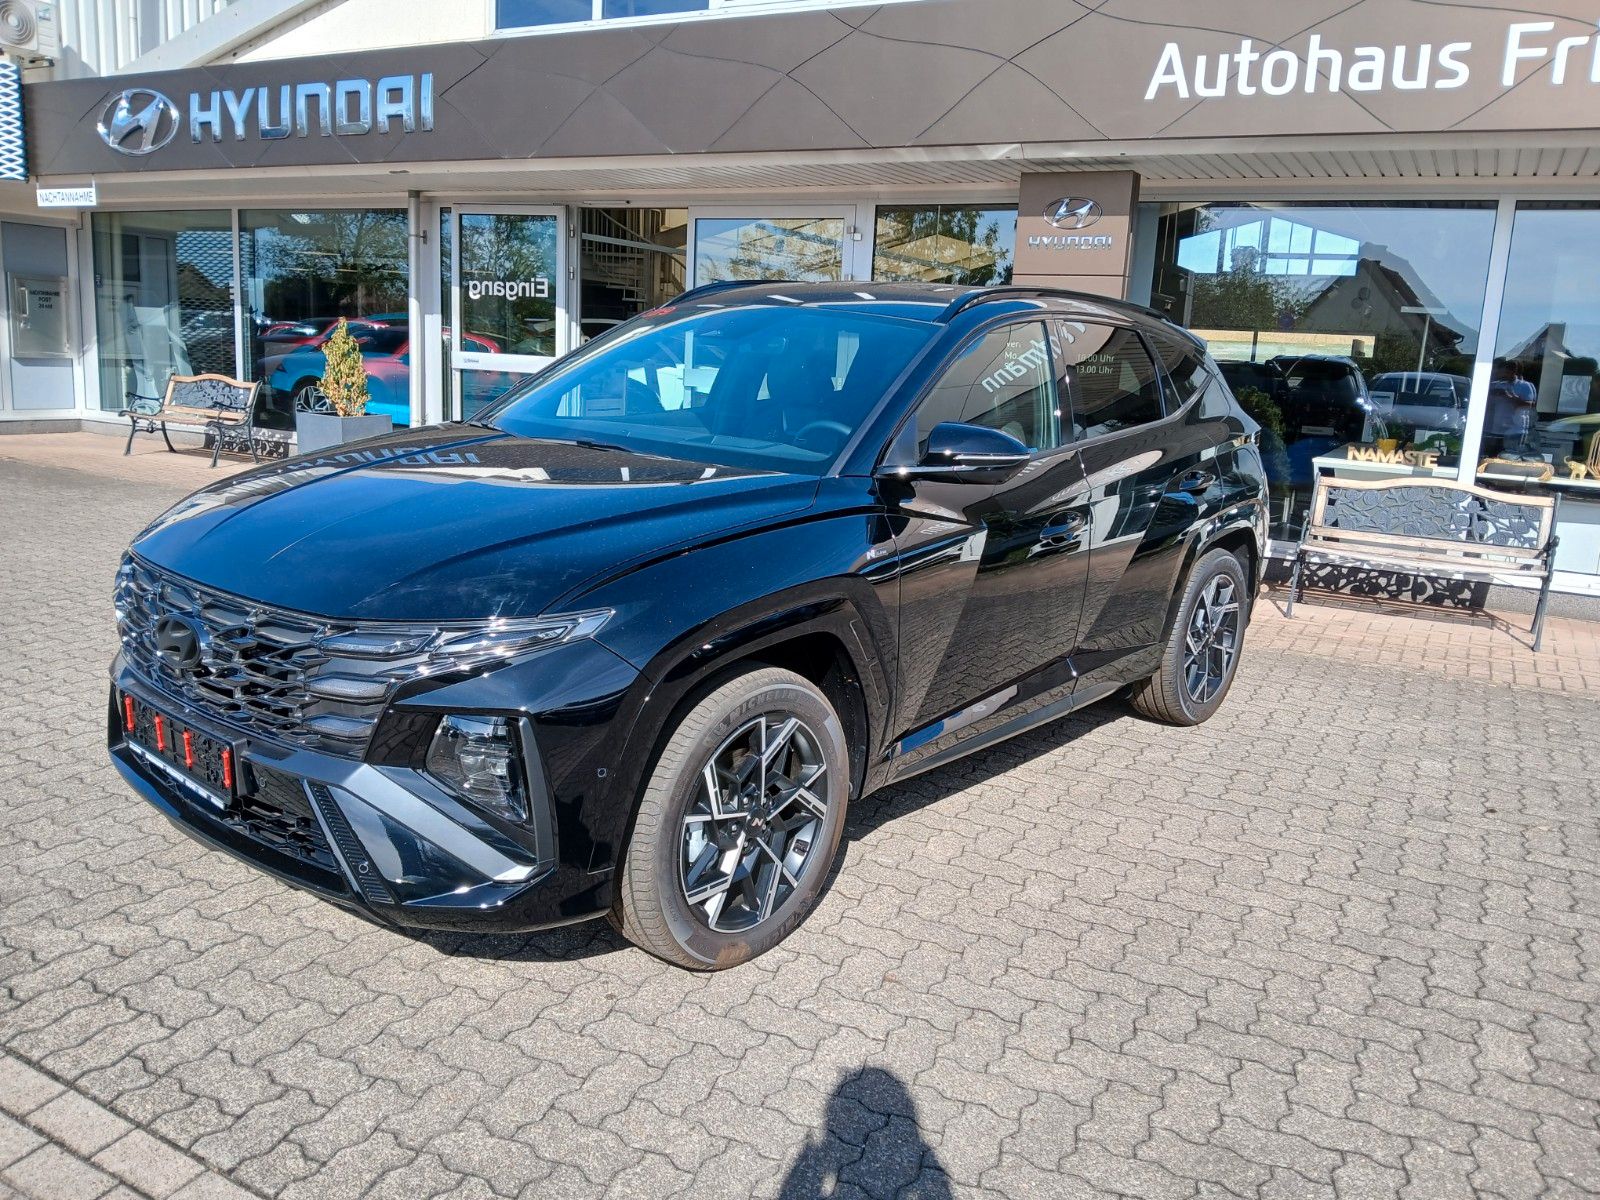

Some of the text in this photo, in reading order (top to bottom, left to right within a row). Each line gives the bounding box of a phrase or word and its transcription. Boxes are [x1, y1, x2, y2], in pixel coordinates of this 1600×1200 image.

[1143, 34, 1472, 100] Autohaus
[189, 72, 434, 144] HYUNDAI
[1028, 235, 1112, 249] HYUNDAI
[1100, 354, 1116, 362] Uhr
[1076, 365, 1115, 374] 13.00 Uhr
[1346, 445, 1441, 468] NAMASTE
